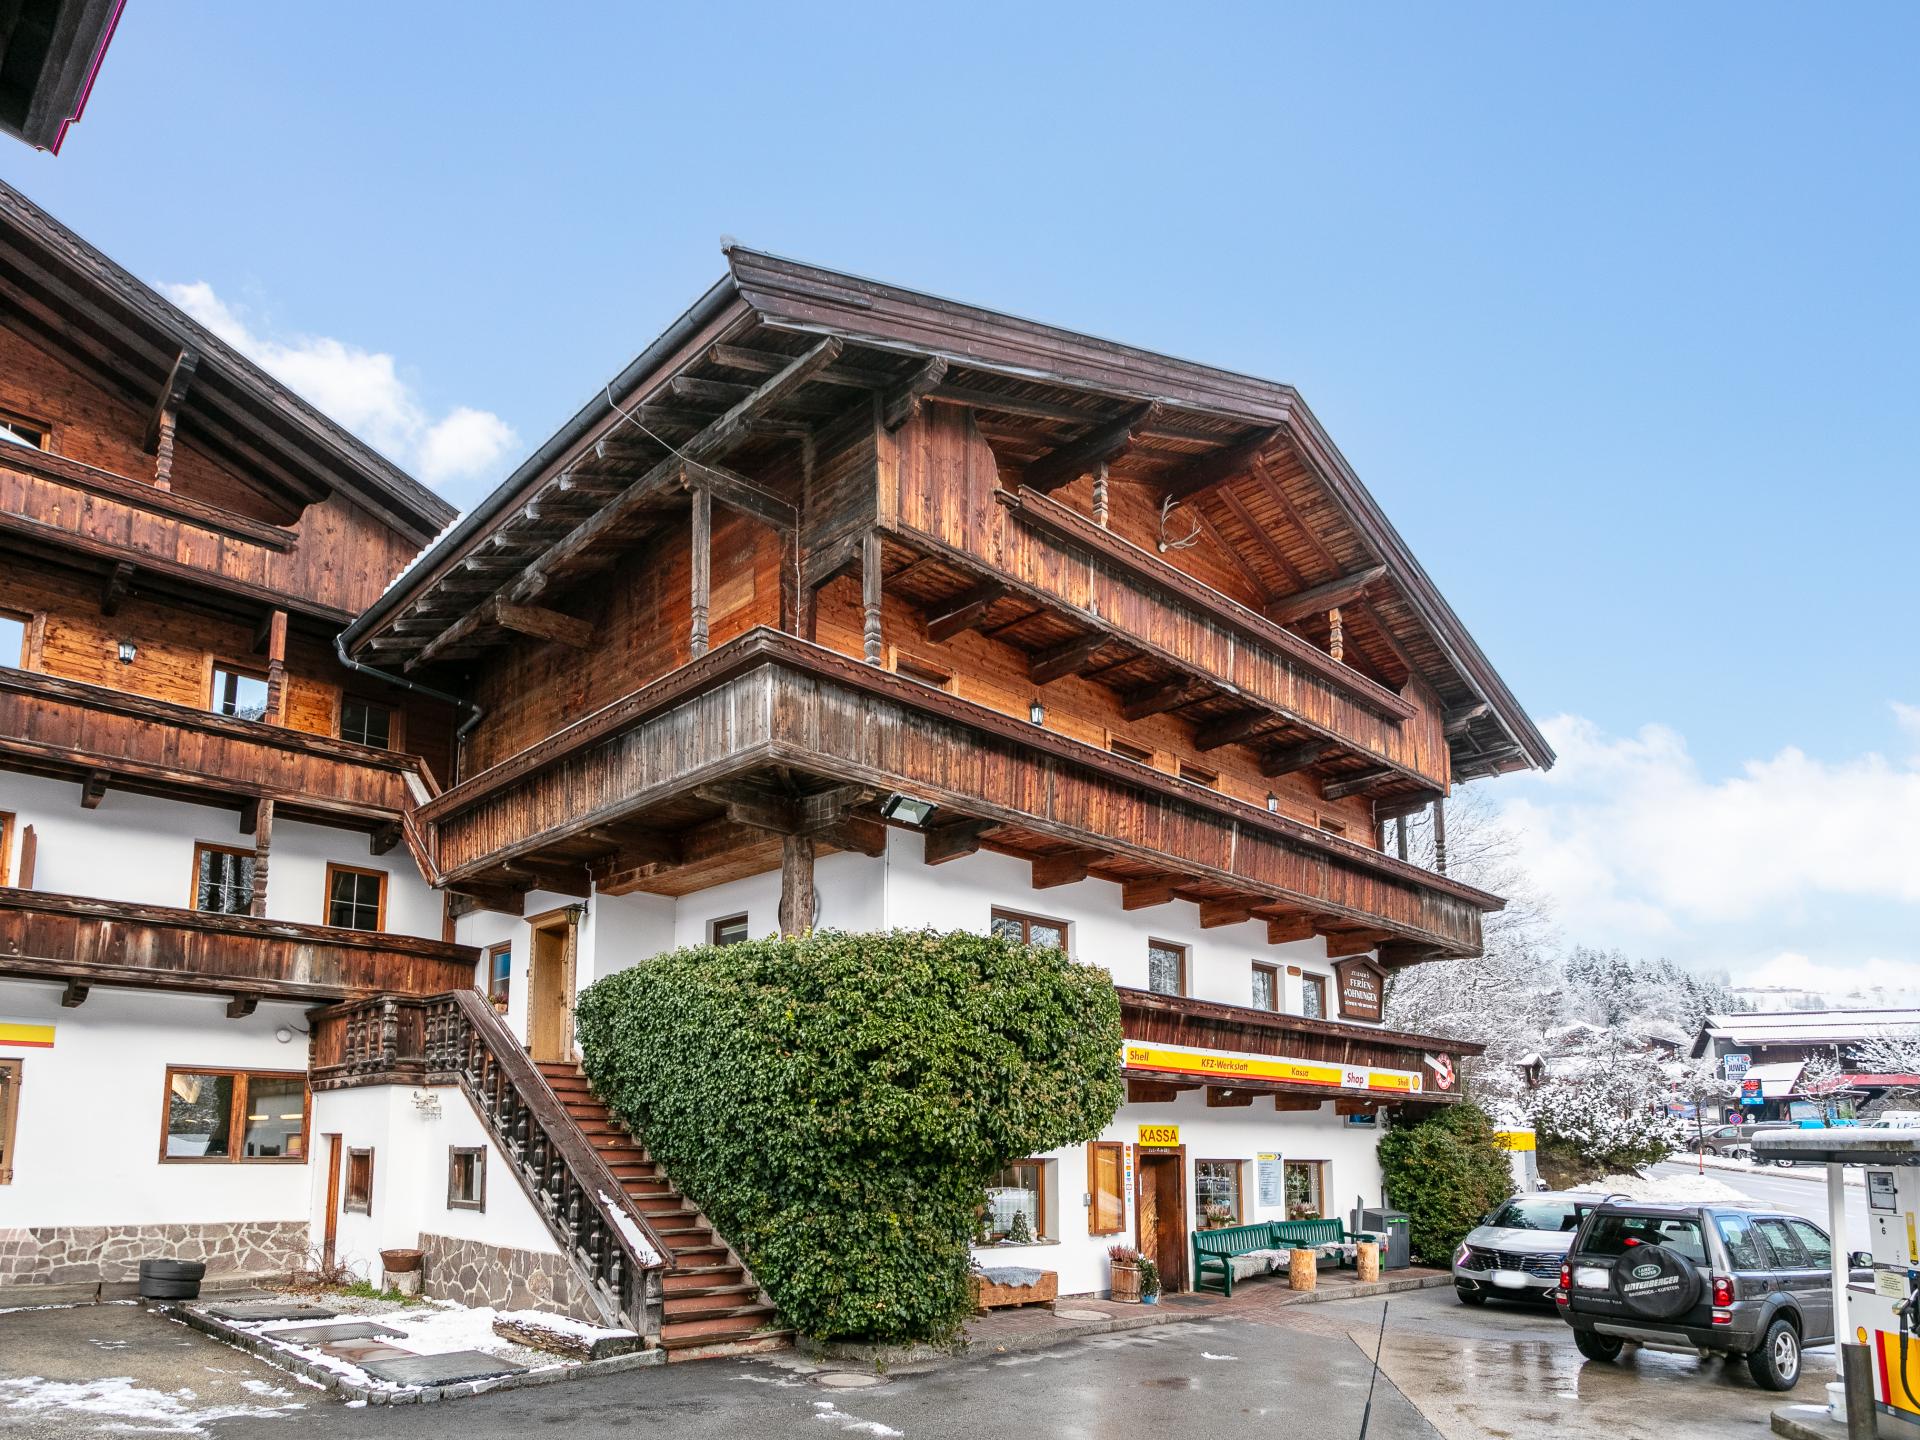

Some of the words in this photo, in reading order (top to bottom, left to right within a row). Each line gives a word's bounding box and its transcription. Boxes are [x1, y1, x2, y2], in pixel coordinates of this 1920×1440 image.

[1130, 1050, 1149, 1061] Shell
[1201, 1058, 1248, 1071] KFZ-Werkstatt
[1291, 1067, 1309, 1077] Kassa
[1347, 1072, 1364, 1087] Shop
[1397, 1078, 1409, 1086] Shell
[1140, 1129, 1177, 1142] KASSA
[1881, 1227, 1886, 1235] 6
